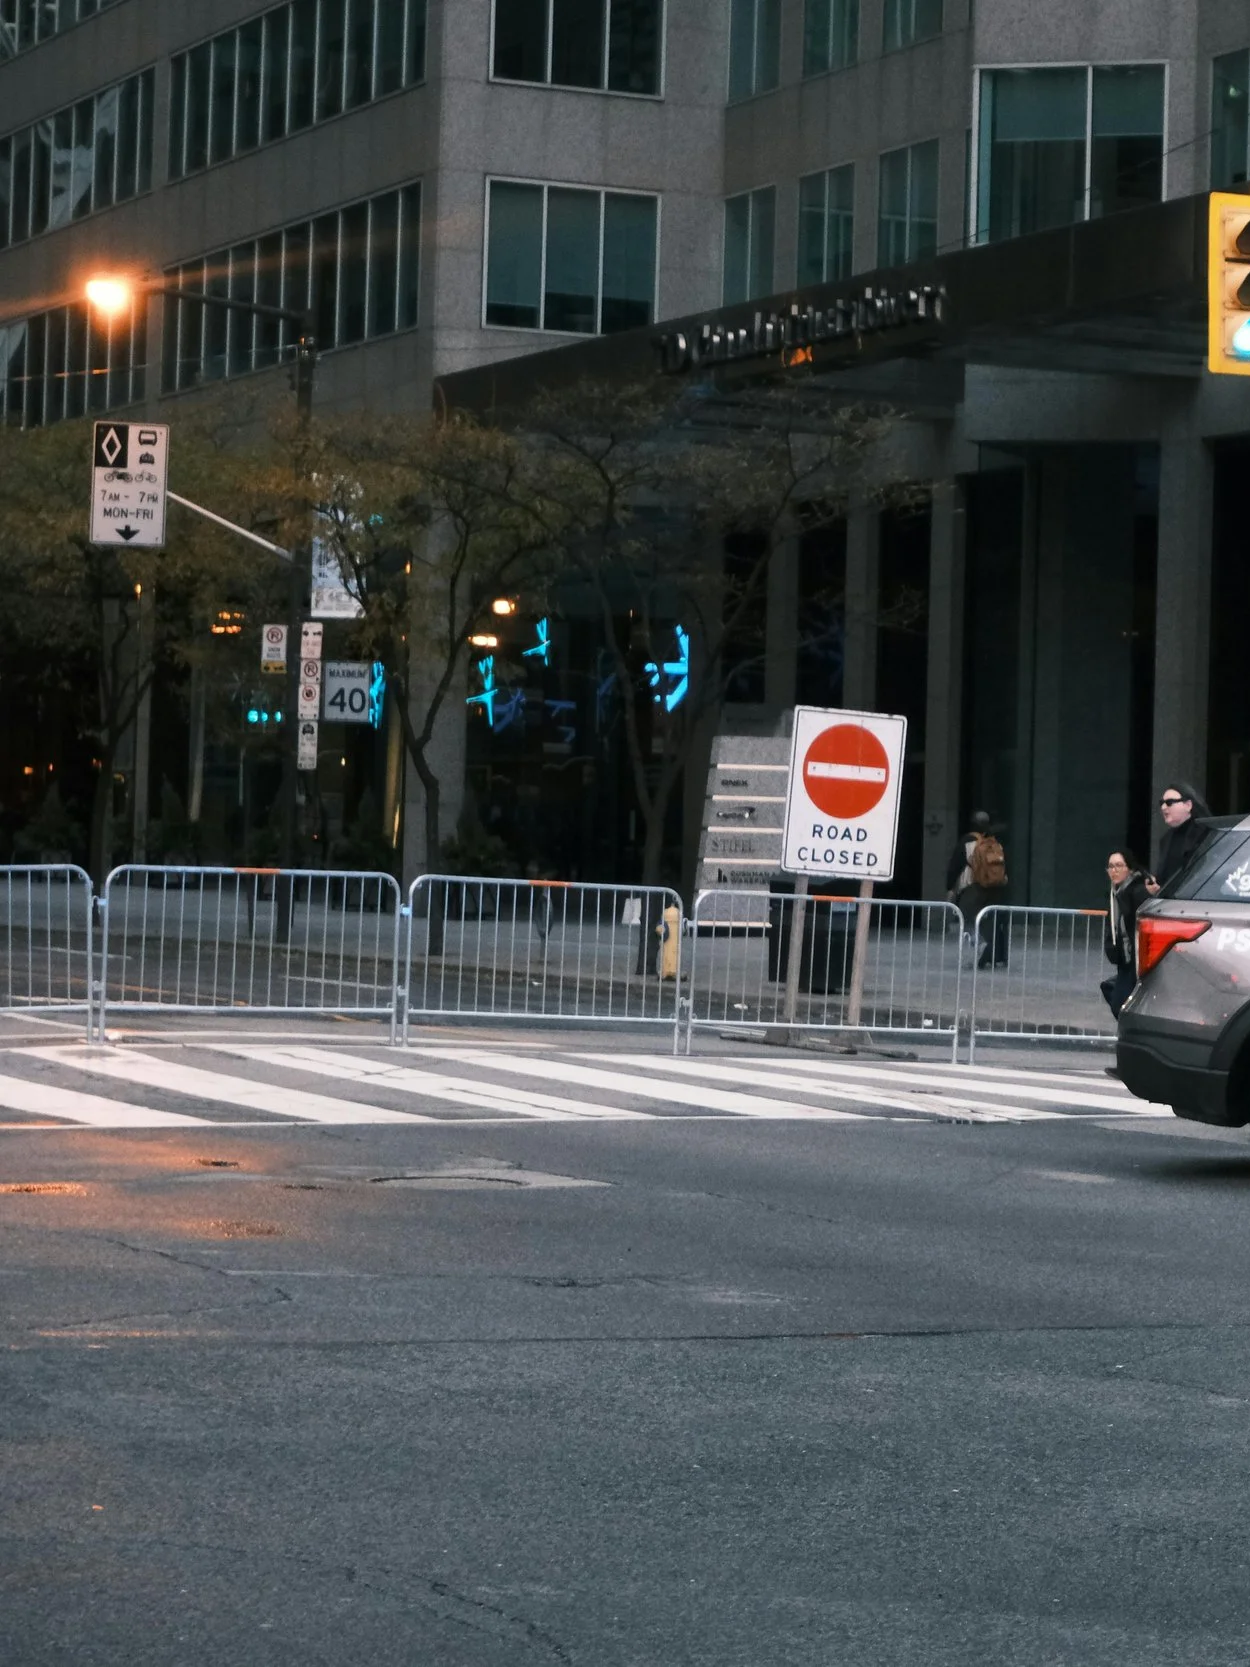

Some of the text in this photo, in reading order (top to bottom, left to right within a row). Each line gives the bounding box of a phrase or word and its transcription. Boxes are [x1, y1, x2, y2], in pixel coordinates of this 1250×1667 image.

[103, 507, 154, 520] MON-FRI
[329, 668, 367, 679] MAXIMUM
[329, 687, 367, 713] 40
[812, 824, 868, 842] ROAD
[797, 847, 878, 867] CLOSED
